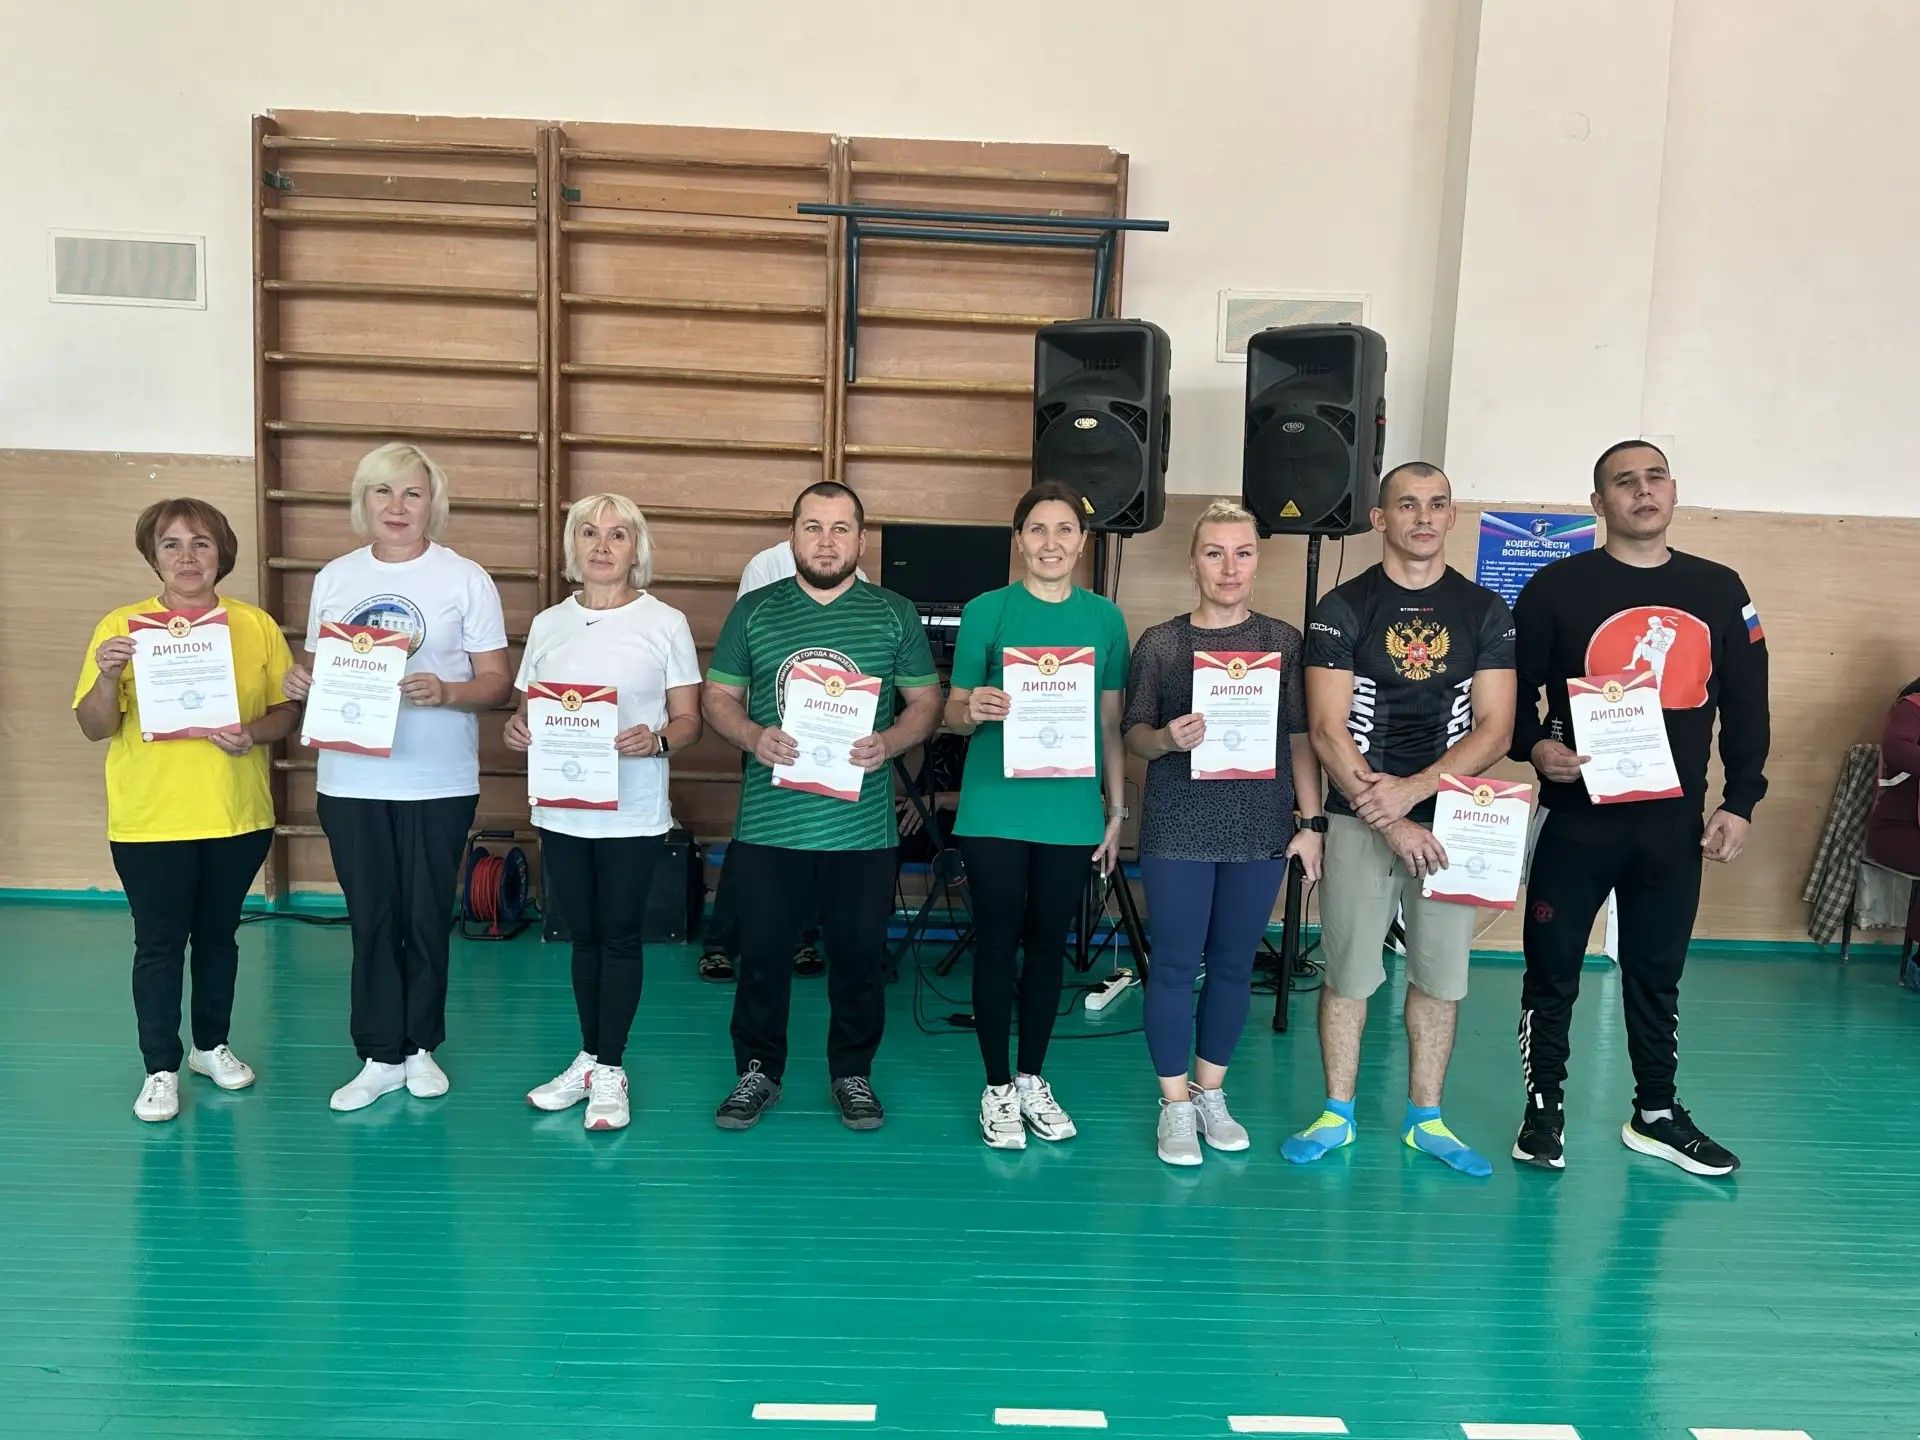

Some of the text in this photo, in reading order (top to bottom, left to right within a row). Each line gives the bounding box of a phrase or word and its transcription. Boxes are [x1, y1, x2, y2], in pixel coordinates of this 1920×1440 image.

[1505, 540, 1570, 549] КОДЕКС ЧЕСТИ
[1502, 548, 1571, 558] ВОЛЕЙБОЛИСТА
[152, 642, 212, 657] ДИПЛОМ
[800, 650, 828, 659] ГОРОДА
[332, 656, 387, 672] ДИПЛОМ
[1021, 681, 1077, 692] ДИПЛОМ
[1210, 685, 1263, 696] ДИПЛОМ
[804, 698, 859, 716] ДИПЛОМ
[1590, 706, 1645, 722] ДИПЛОМ
[545, 715, 600, 728] ДИПЛОМ
[1453, 809, 1510, 825] ДИПЛОМ
